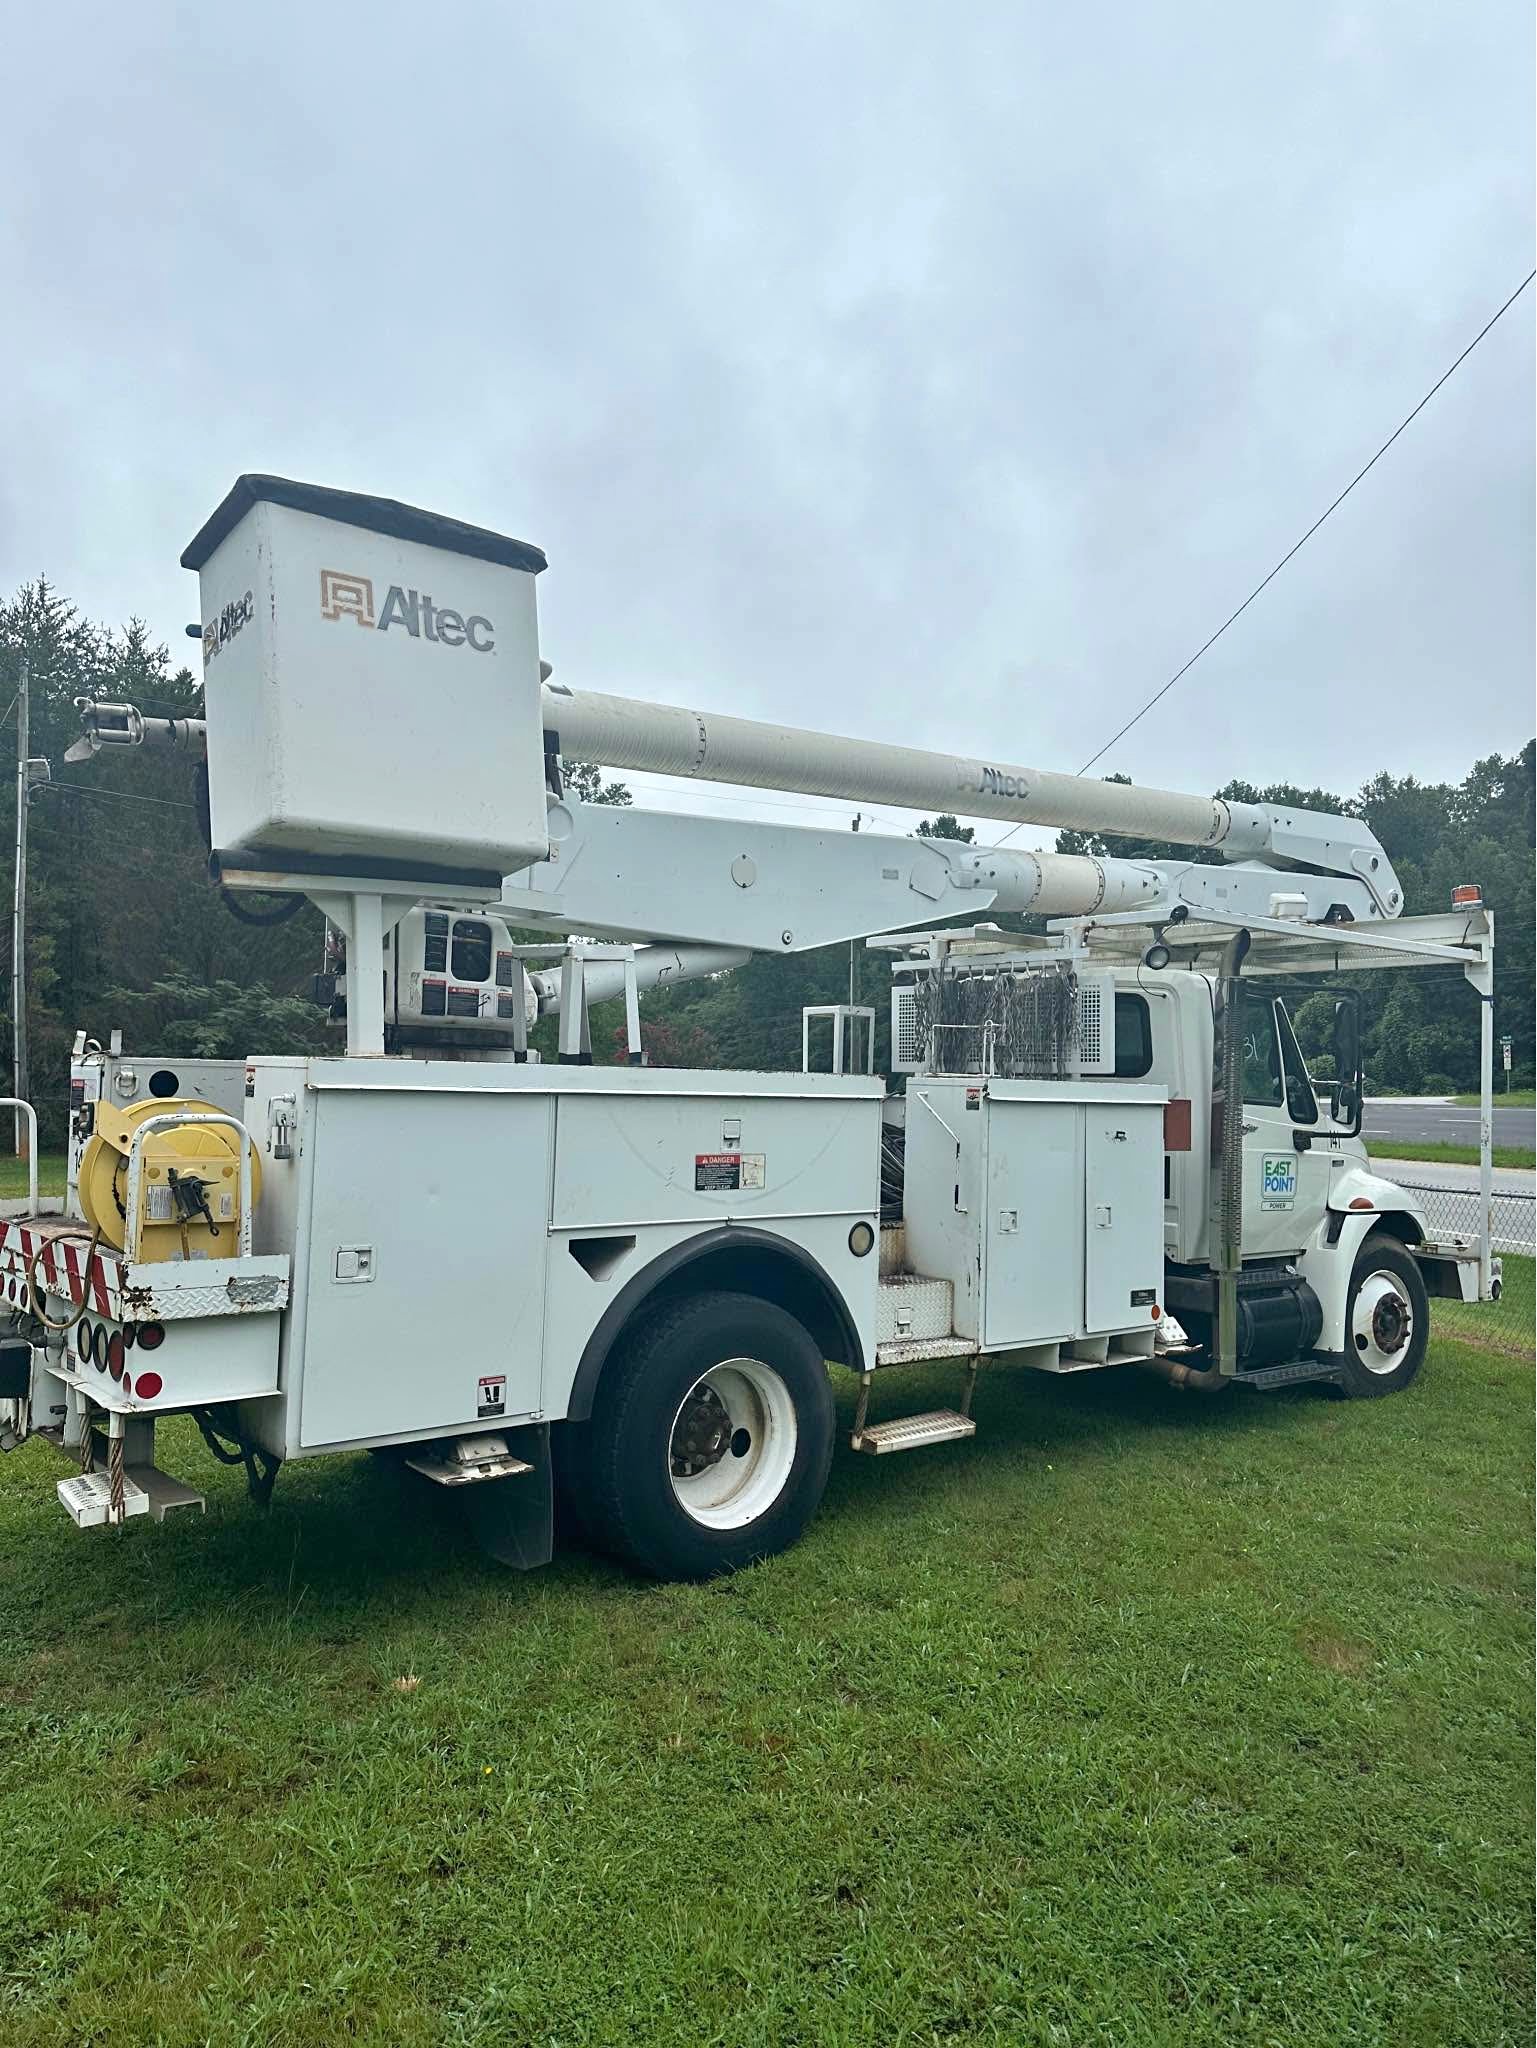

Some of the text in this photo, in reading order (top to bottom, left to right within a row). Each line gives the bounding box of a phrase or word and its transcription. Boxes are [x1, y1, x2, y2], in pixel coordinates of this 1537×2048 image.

[219, 590, 254, 643] Altec
[377, 585, 495, 652] Altec
[978, 767, 1031, 799] Altec
[709, 1156, 735, 1164] DANGER
[1265, 1161, 1292, 1176] EAST
[1264, 1177, 1294, 1192] POINT
